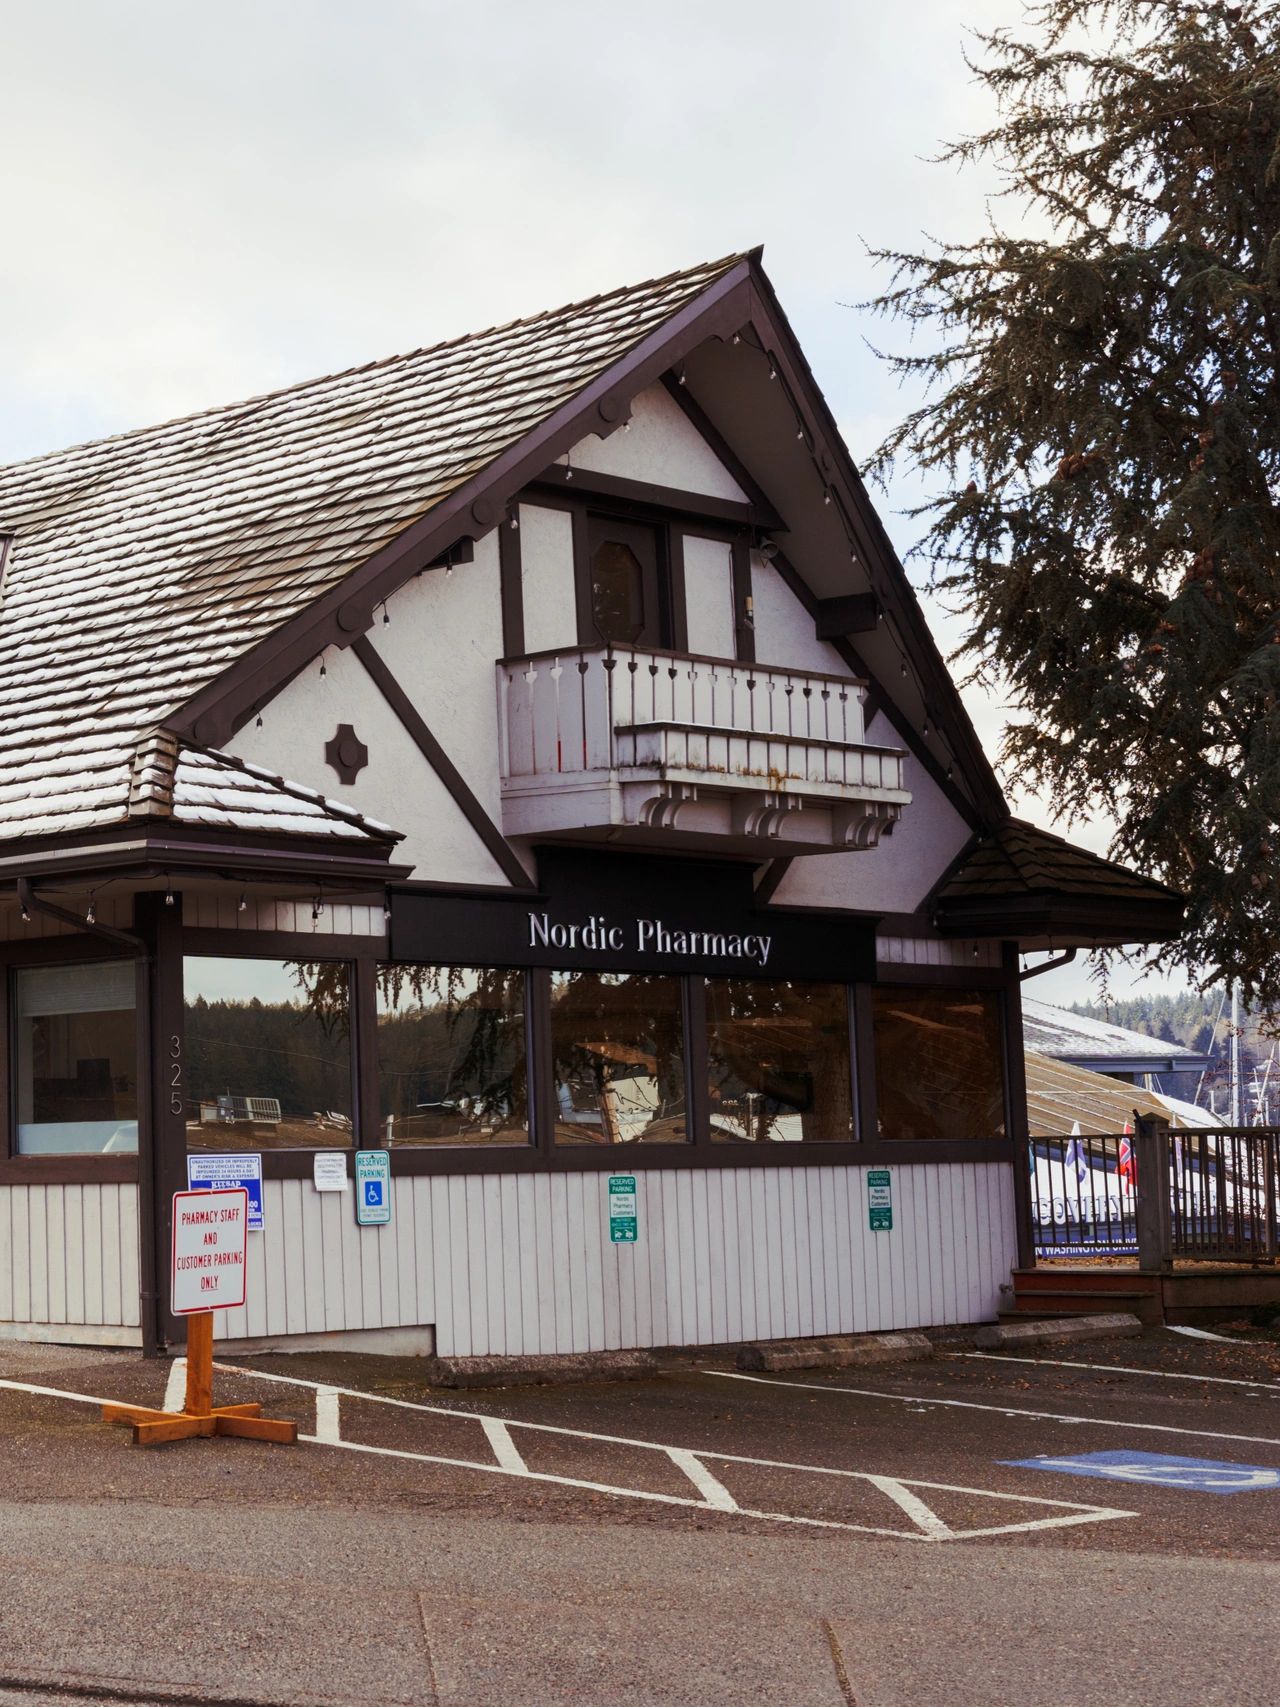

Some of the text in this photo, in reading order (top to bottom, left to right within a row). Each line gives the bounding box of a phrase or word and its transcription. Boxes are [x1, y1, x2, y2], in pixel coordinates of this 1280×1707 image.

[528, 912, 771, 967] Nordic Pharmacy
[169, 1035, 182, 1114] 325
[358, 1157, 387, 1166] RESERVED
[360, 1169, 385, 1178] PARKING
[181, 1208, 240, 1226] PHARMACY STAFF
[203, 1232, 218, 1245] AND
[176, 1251, 243, 1270] CUSTOMER PARKING
[200, 1275, 219, 1290] ONLY
